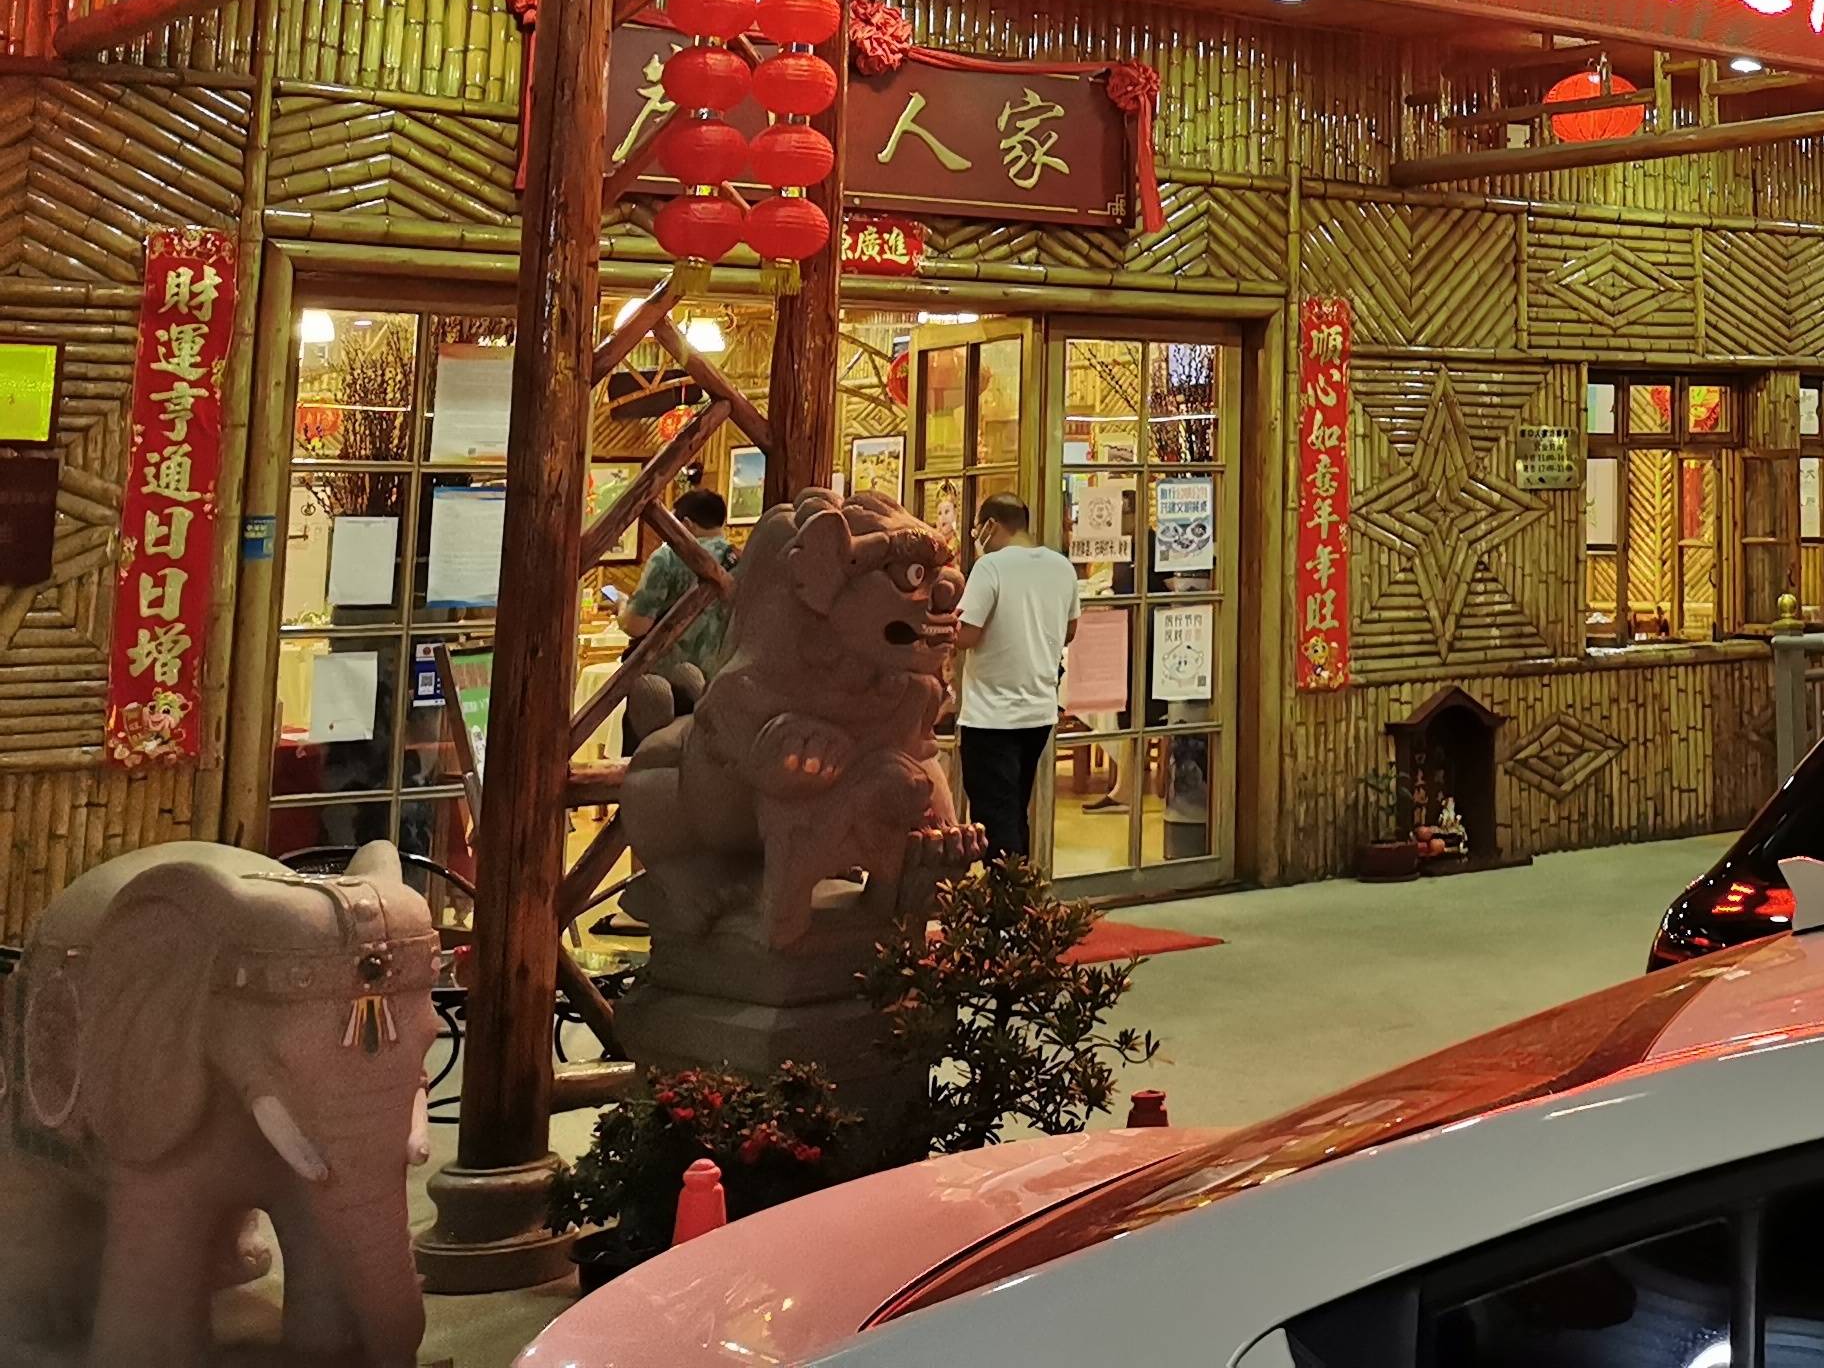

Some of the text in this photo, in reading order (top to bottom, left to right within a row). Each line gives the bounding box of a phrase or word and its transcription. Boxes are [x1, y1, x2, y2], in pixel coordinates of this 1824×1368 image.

[126, 265, 224, 687] 財運亨通日日增
[1304, 323, 1344, 633] 順心如意年年旺
